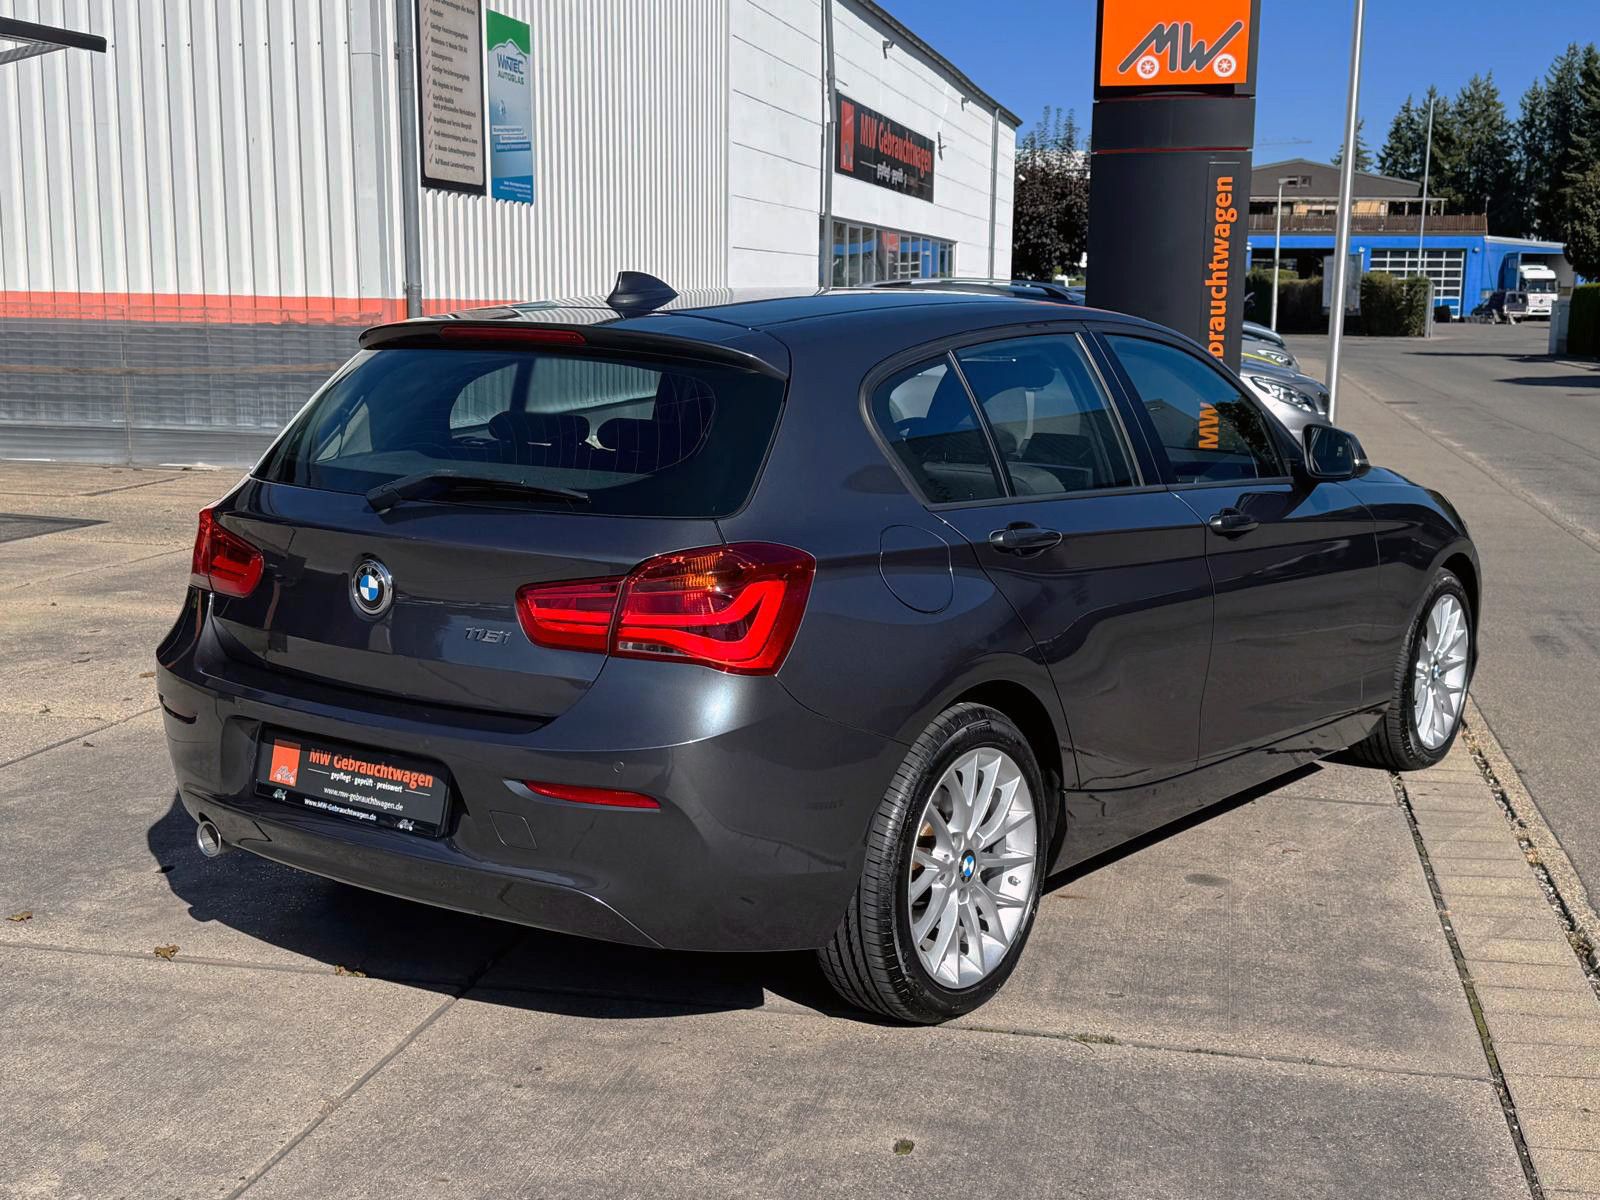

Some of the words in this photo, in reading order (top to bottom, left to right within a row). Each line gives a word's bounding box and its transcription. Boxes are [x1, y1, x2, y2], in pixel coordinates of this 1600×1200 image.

[1117, 20, 1244, 74] MW
[497, 70, 525, 85] AUTOGLAS
[860, 113, 878, 149] MW
[879, 121, 932, 178] Gebrauchtwagen
[1205, 176, 1238, 360] brauchtwagen
[1198, 402, 1219, 449] MW
[309, 749, 331, 766] MW
[333, 754, 433, 790] Gebrauchtwagen
[330, 772, 352, 783] gepflegt
[353, 777, 374, 787] geprüft
[376, 781, 403, 793] preiswert
[323, 787, 404, 811] www.mw-gebrauchtwagen.de
